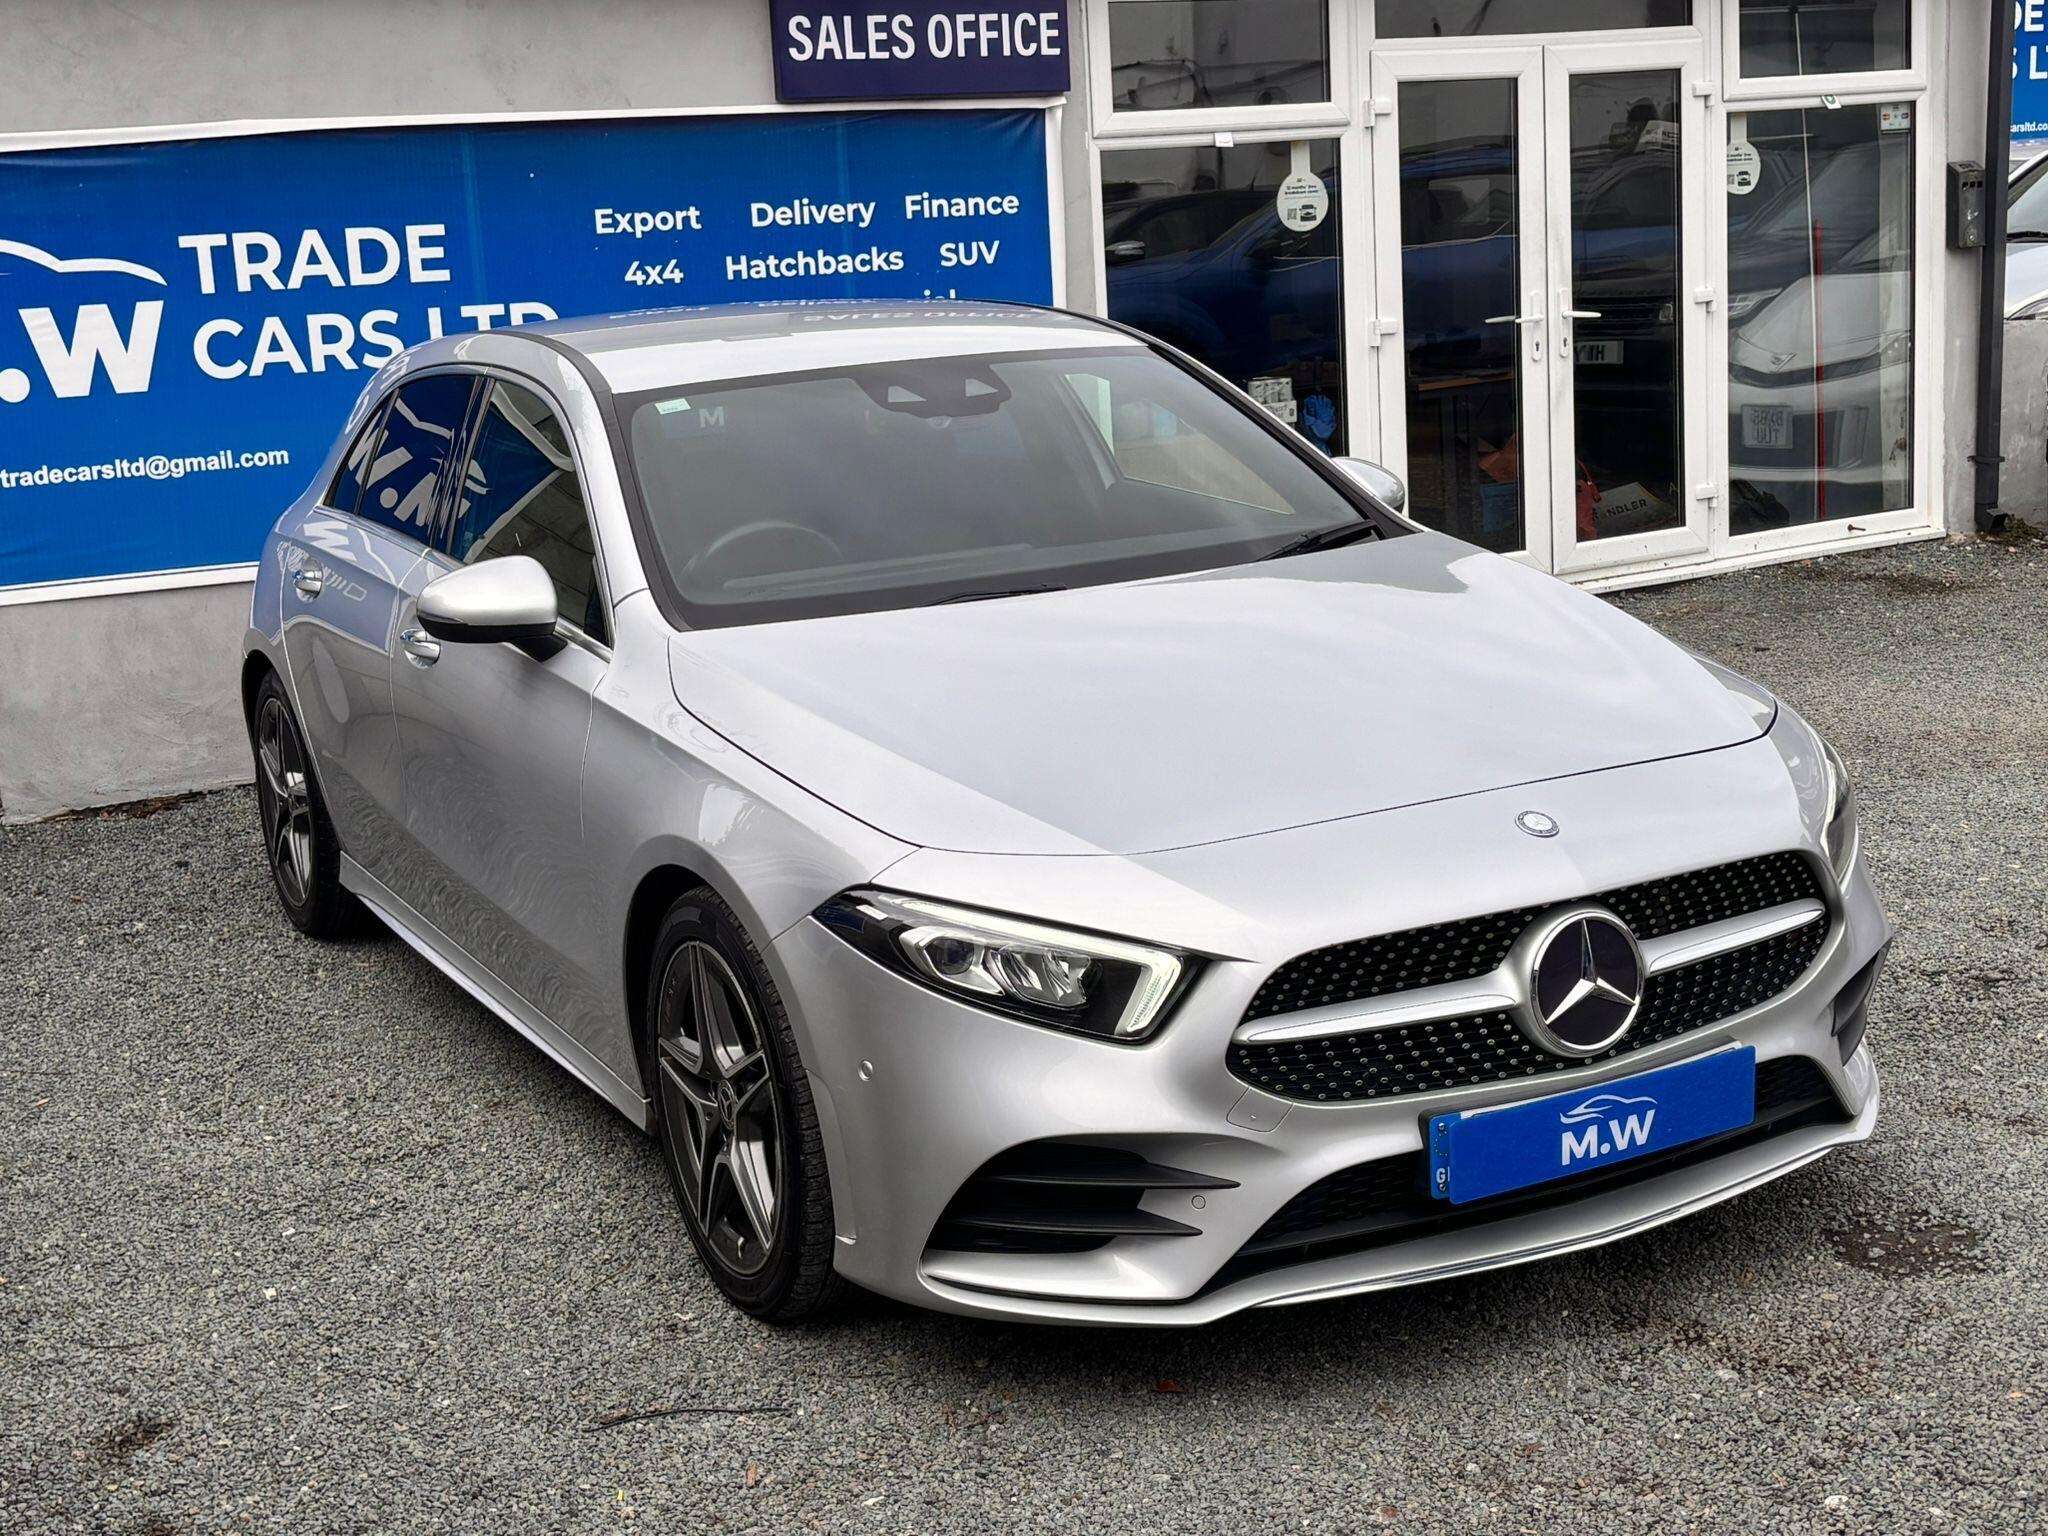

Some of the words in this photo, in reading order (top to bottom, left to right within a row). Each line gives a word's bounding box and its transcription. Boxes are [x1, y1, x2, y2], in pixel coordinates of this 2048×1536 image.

[788, 13, 915, 62] SALES
[927, 12, 1061, 59] OFFICE
[594, 206, 702, 239] Export
[750, 197, 876, 229] Delivery
[905, 191, 1019, 220] Finance
[178, 223, 451, 294] TRADE
[624, 258, 684, 287] 4x4
[726, 246, 905, 281] Hatchbacks
[939, 240, 1000, 268] SUV
[193, 309, 404, 379] CARS
[1561, 1108, 1656, 1166] M.W
